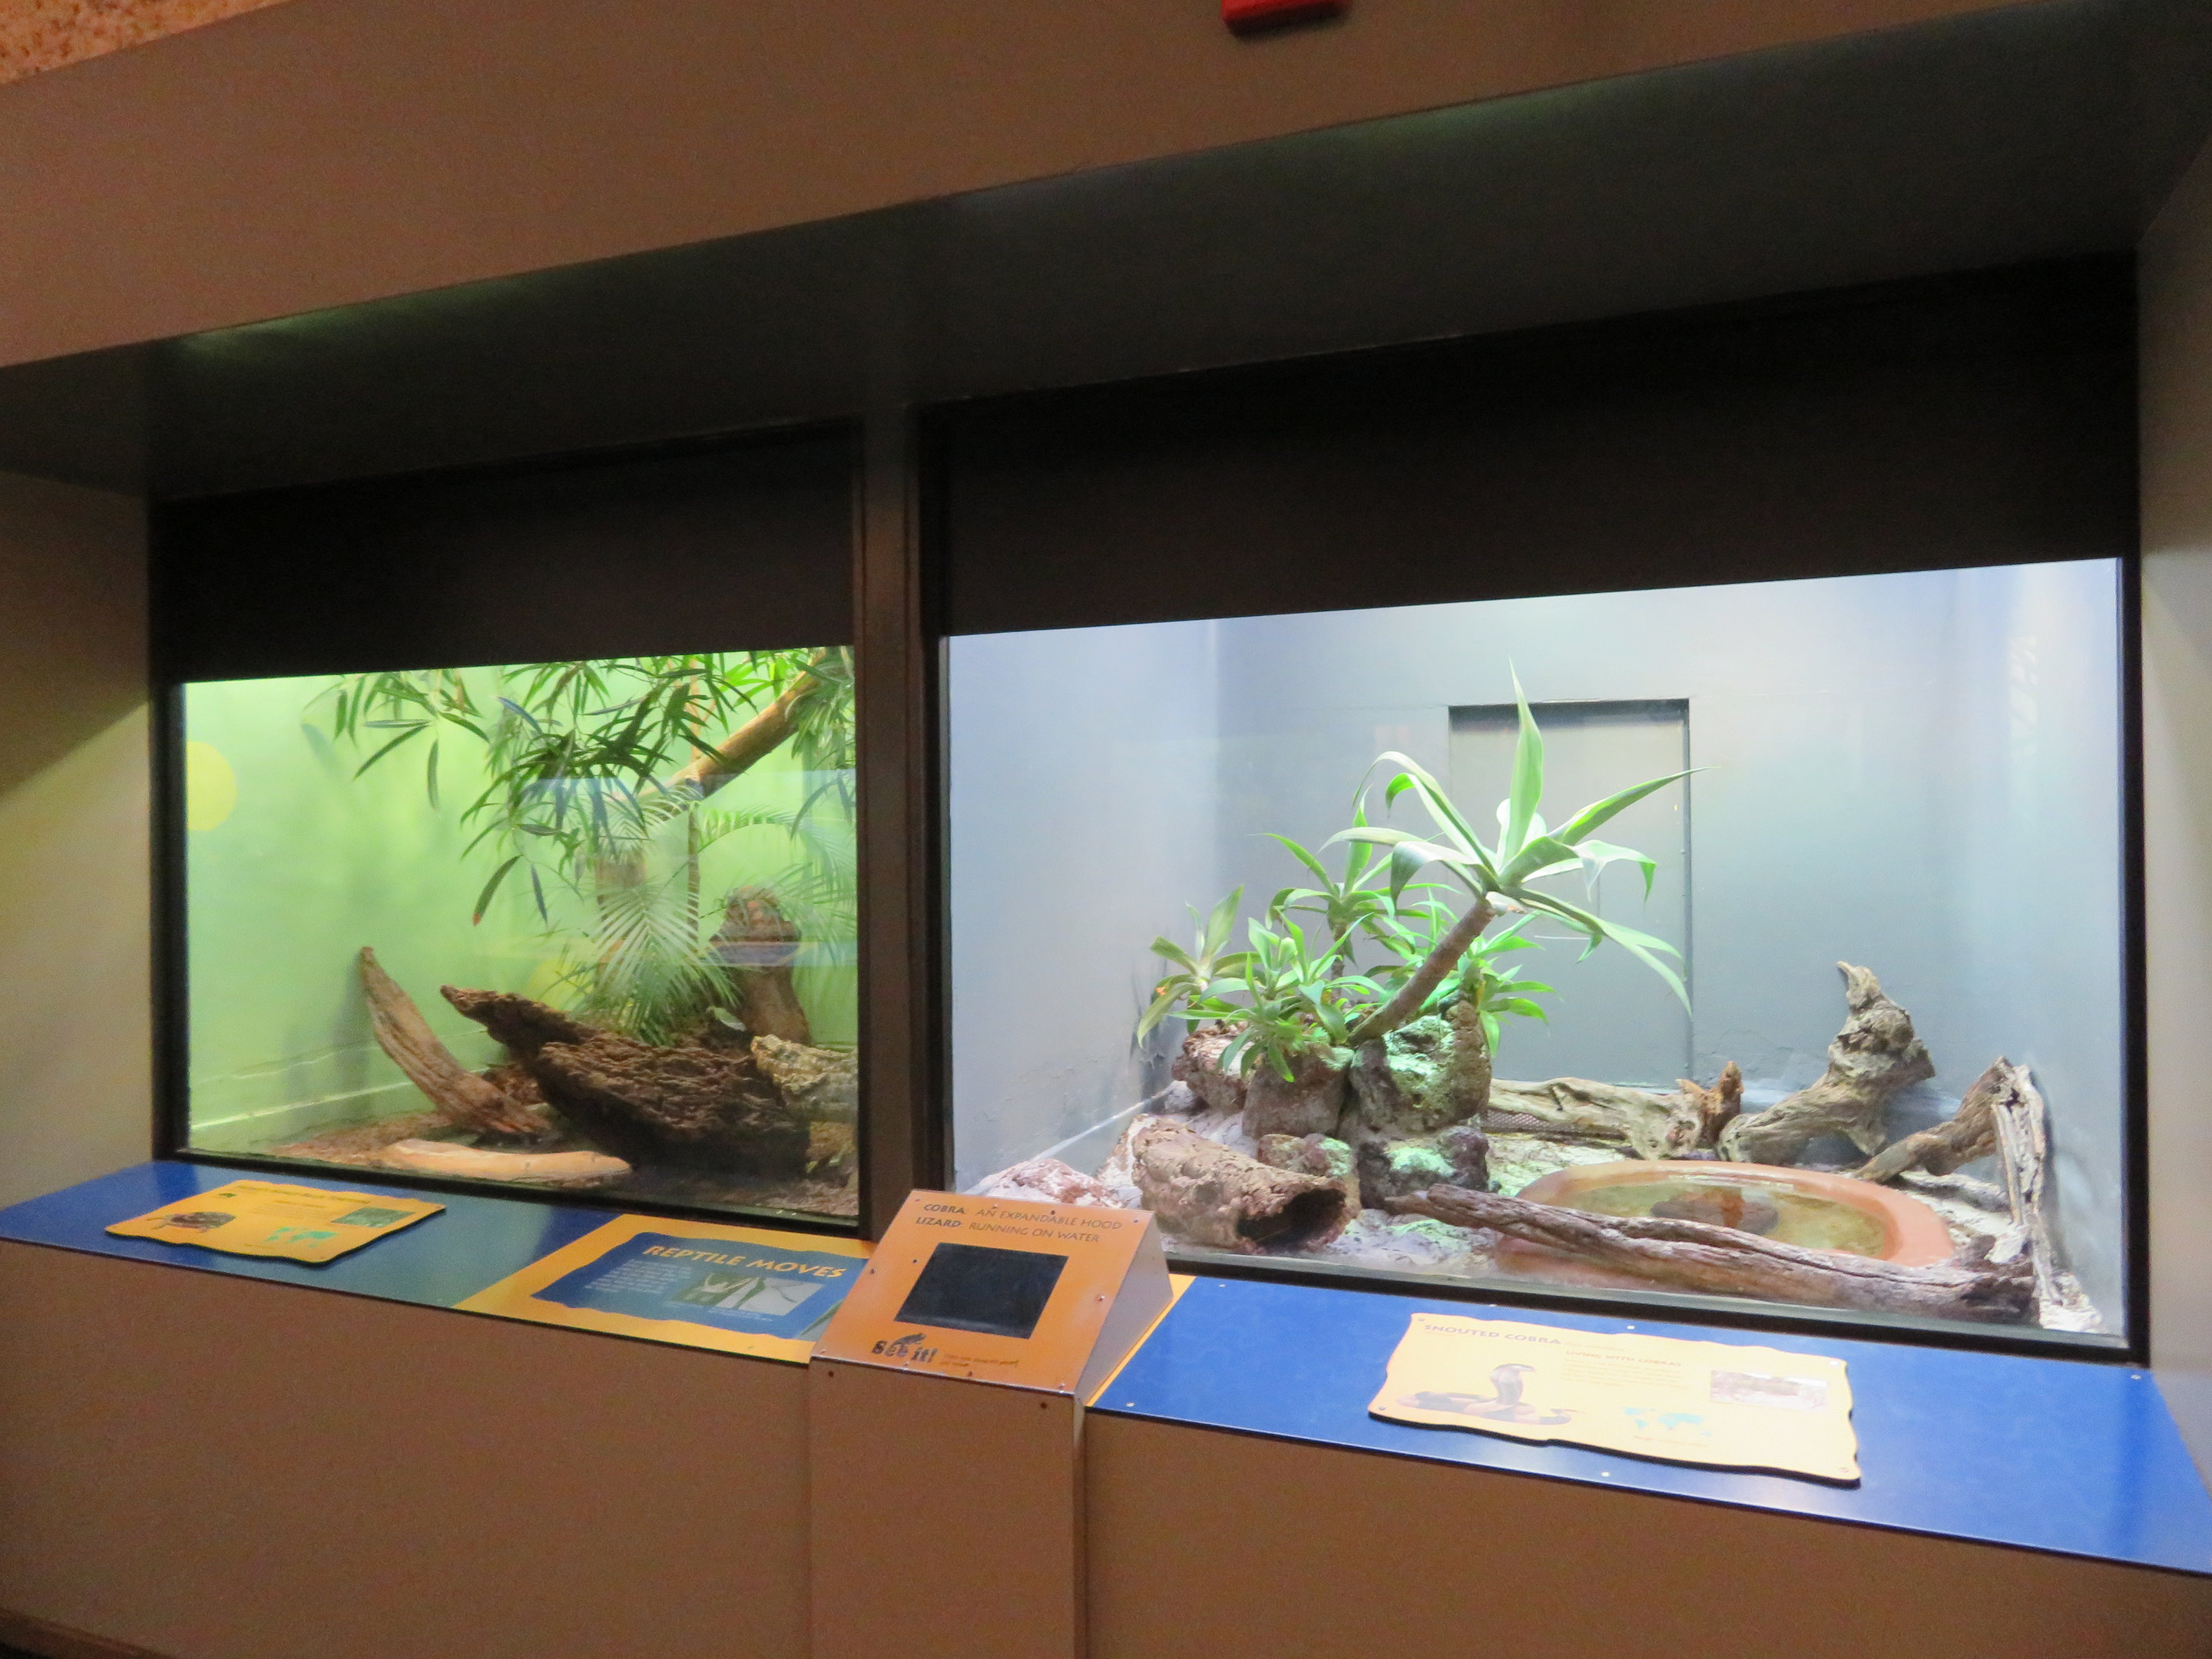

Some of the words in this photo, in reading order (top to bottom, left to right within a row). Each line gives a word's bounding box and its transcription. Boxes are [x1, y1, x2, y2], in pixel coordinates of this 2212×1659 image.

[976, 1209, 997, 1217] AN
[999, 1210, 1077, 1226] EXPANDABLE
[1081, 1219, 1123, 1230] HOOD
[969, 1222, 1028, 1236] RUNNING
[1031, 1228, 1053, 1237] ON
[1057, 1231, 1100, 1243] WATER
[642, 1245, 746, 1266] REPTILE
[746, 1260, 846, 1278] MOVES
[1424, 1324, 1500, 1338] SNOUTED
[1504, 1333, 1561, 1345] COBRA
